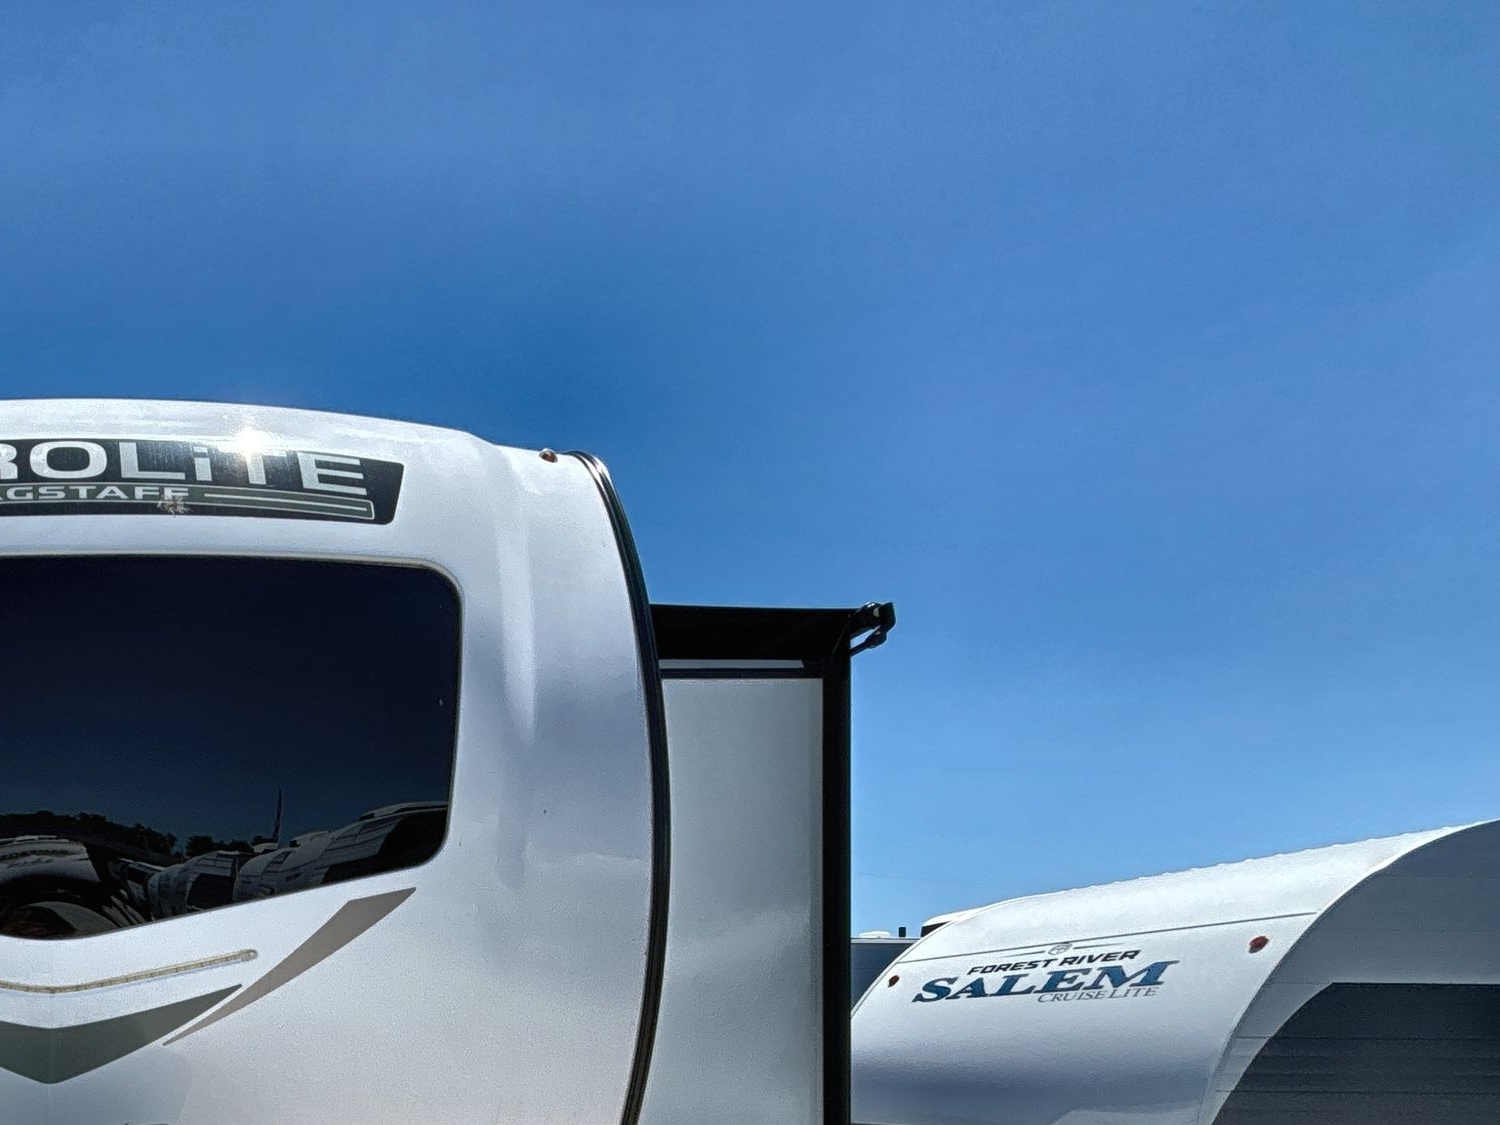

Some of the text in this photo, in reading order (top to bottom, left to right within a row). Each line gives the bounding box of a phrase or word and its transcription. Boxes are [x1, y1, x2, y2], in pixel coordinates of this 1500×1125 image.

[967, 950, 1141, 975] FOREST RIVER
[911, 960, 1180, 1003] SALEM
